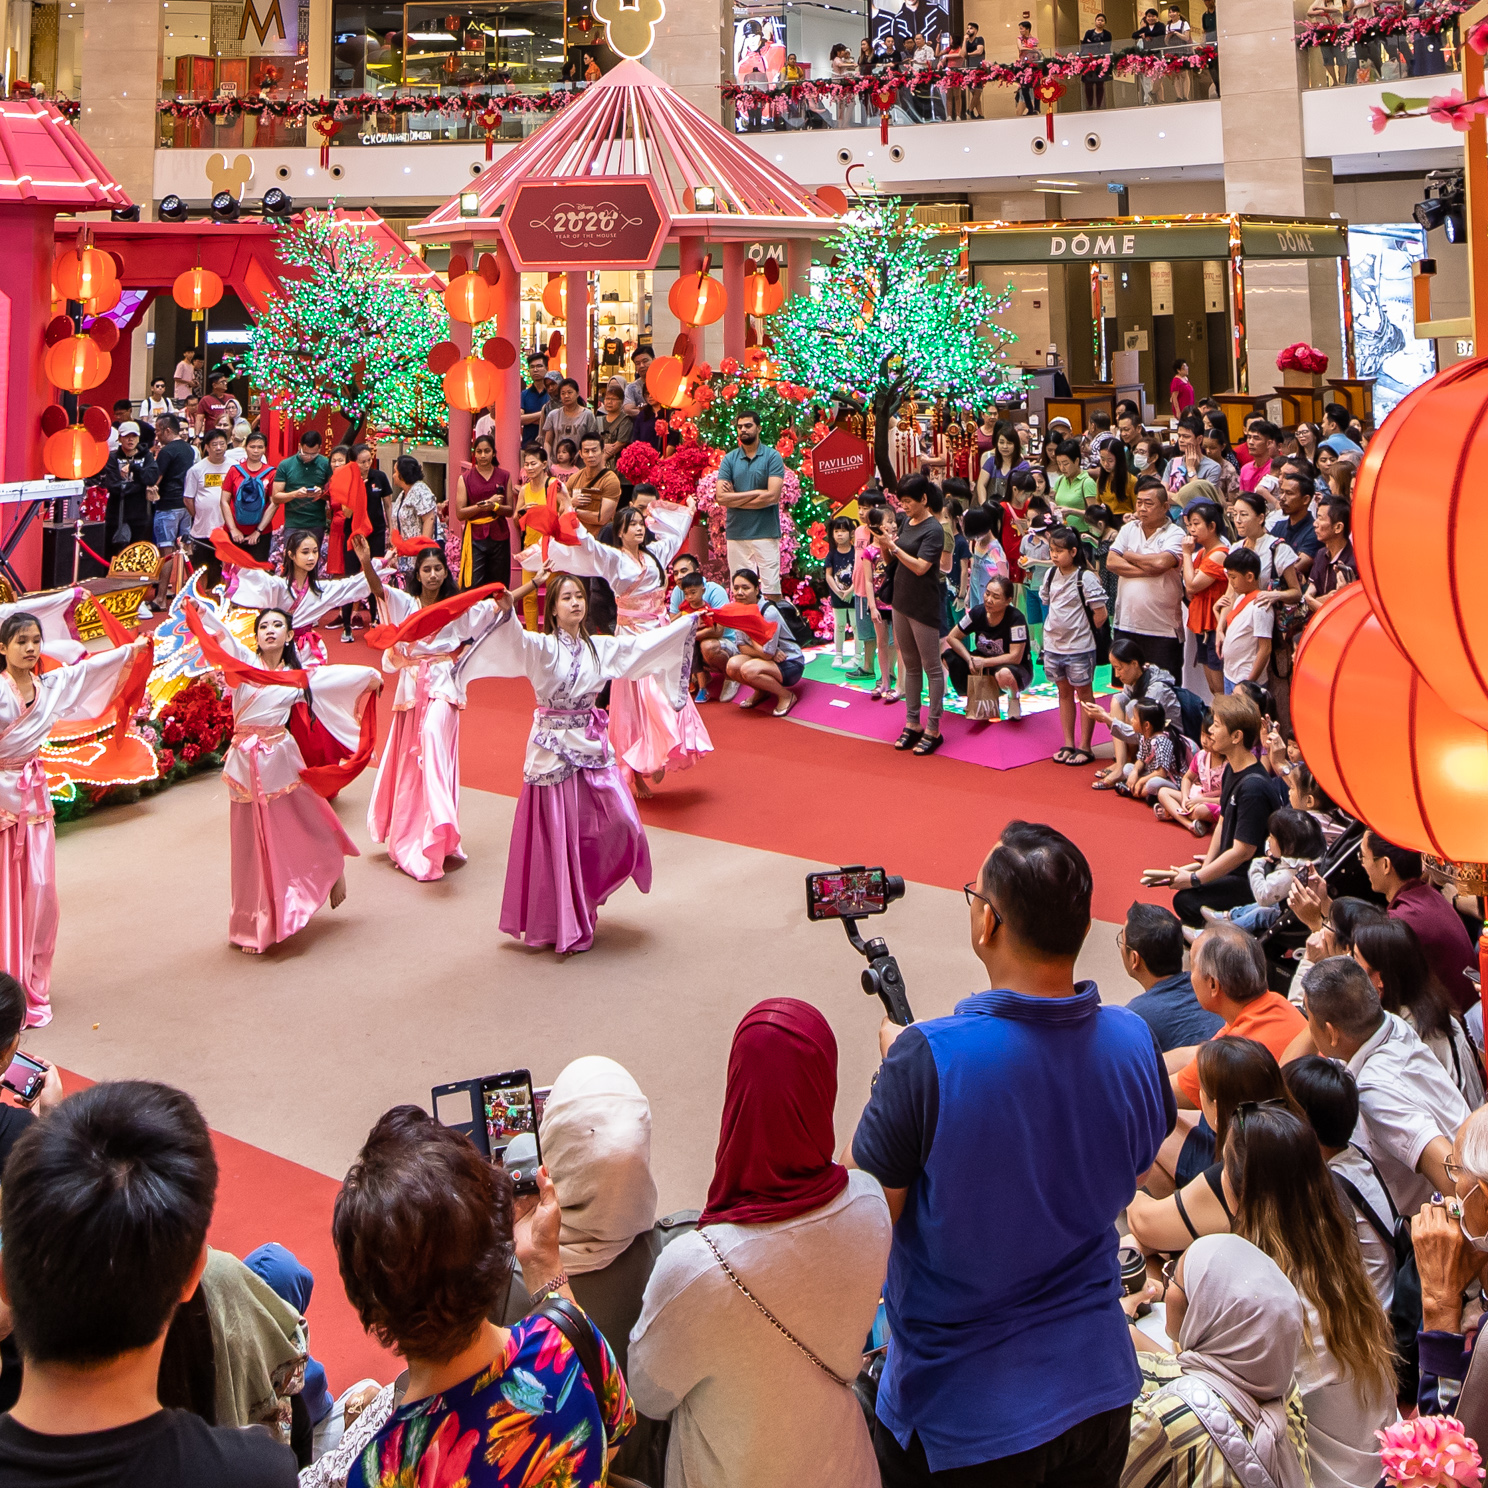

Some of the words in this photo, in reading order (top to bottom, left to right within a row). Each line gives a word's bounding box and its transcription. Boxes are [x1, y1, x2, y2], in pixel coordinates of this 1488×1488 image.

[553, 210, 618, 232] 2020
[1050, 232, 1135, 255] DÔME
[1276, 230, 1314, 252] DÔME
[819, 454, 863, 469] PAVILION
